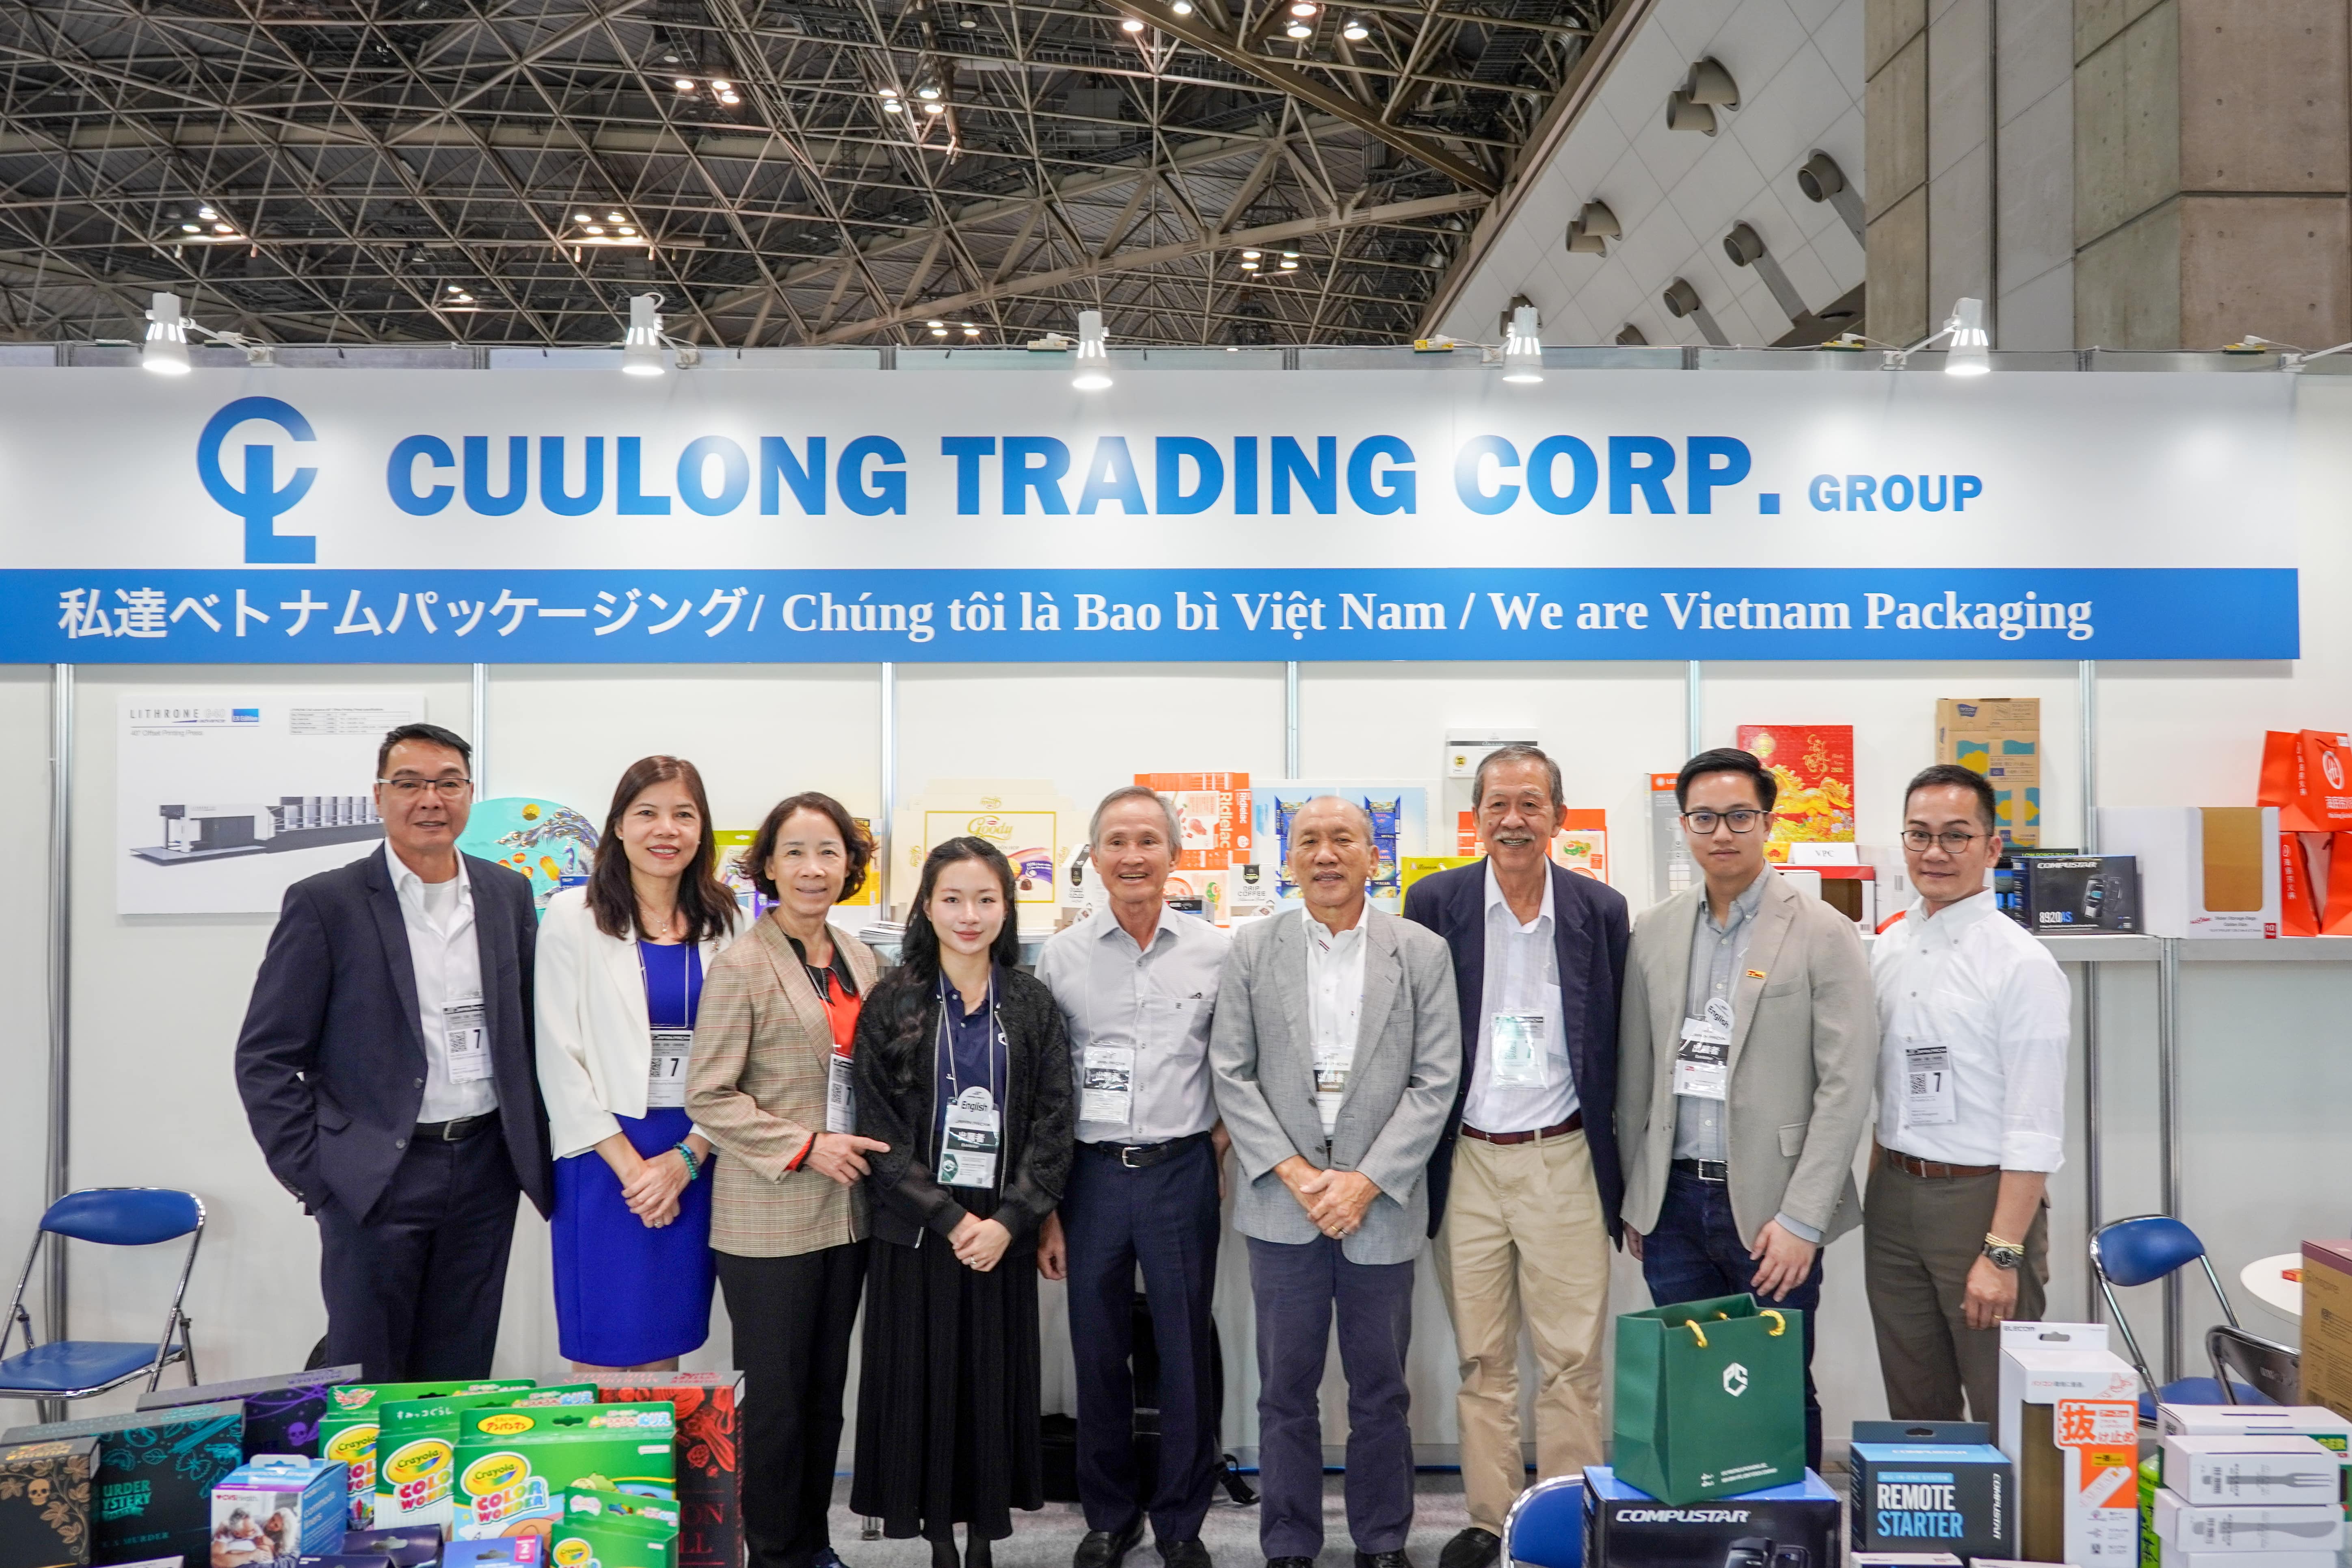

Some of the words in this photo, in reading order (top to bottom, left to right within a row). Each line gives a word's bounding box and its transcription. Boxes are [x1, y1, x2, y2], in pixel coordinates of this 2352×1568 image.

[387, 435, 907, 517] CUULONG
[941, 435, 1416, 516] TRADING
[1455, 435, 1780, 516] CORP.
[1809, 474, 1982, 512] GROUP
[782, 592, 935, 642] Chúng
[948, 591, 1007, 632] tôi
[1019, 591, 1061, 632] là
[1074, 594, 1161, 632] Bao
[1175, 592, 1219, 631] bì
[1232, 591, 1326, 640] Việt
[1339, 593, 1447, 630] Nam
[1459, 593, 1476, 630] /
[1487, 593, 1563, 630] We
[1576, 603, 1649, 630] are
[1661, 591, 1852, 630] Vietnam
[1863, 591, 2095, 641] Packaging
[130, 709, 199, 718] LITHRONE
[1219, 792, 1233, 848] Ridielac
[1239, 792, 1248, 824] Ridielac
[967, 815, 1013, 841] Goody
[1708, 1005, 1729, 1029] English
[473, 1029, 481, 1049] 7
[670, 1058, 679, 1077] 7
[1933, 1072, 1941, 1092] 7
[961, 1101, 988, 1112] English
[397, 1450, 439, 1468] Crayola
[400, 1469, 452, 1499] COLO
[475, 1463, 515, 1481] Crayola
[103, 1480, 151, 1497] URDER
[476, 1480, 543, 1511] COLOR
[1876, 1484, 1956, 1511] REMOTE
[102, 1492, 152, 1510] YSTERY
[478, 1495, 544, 1523] WONDER
[1993, 1473, 2002, 1540] COMPUSTAR
[1615, 1510, 1748, 1523] COMPUSTAR
[1876, 1511, 1964, 1538] STARTER
[521, 1543, 529, 1554] 2
